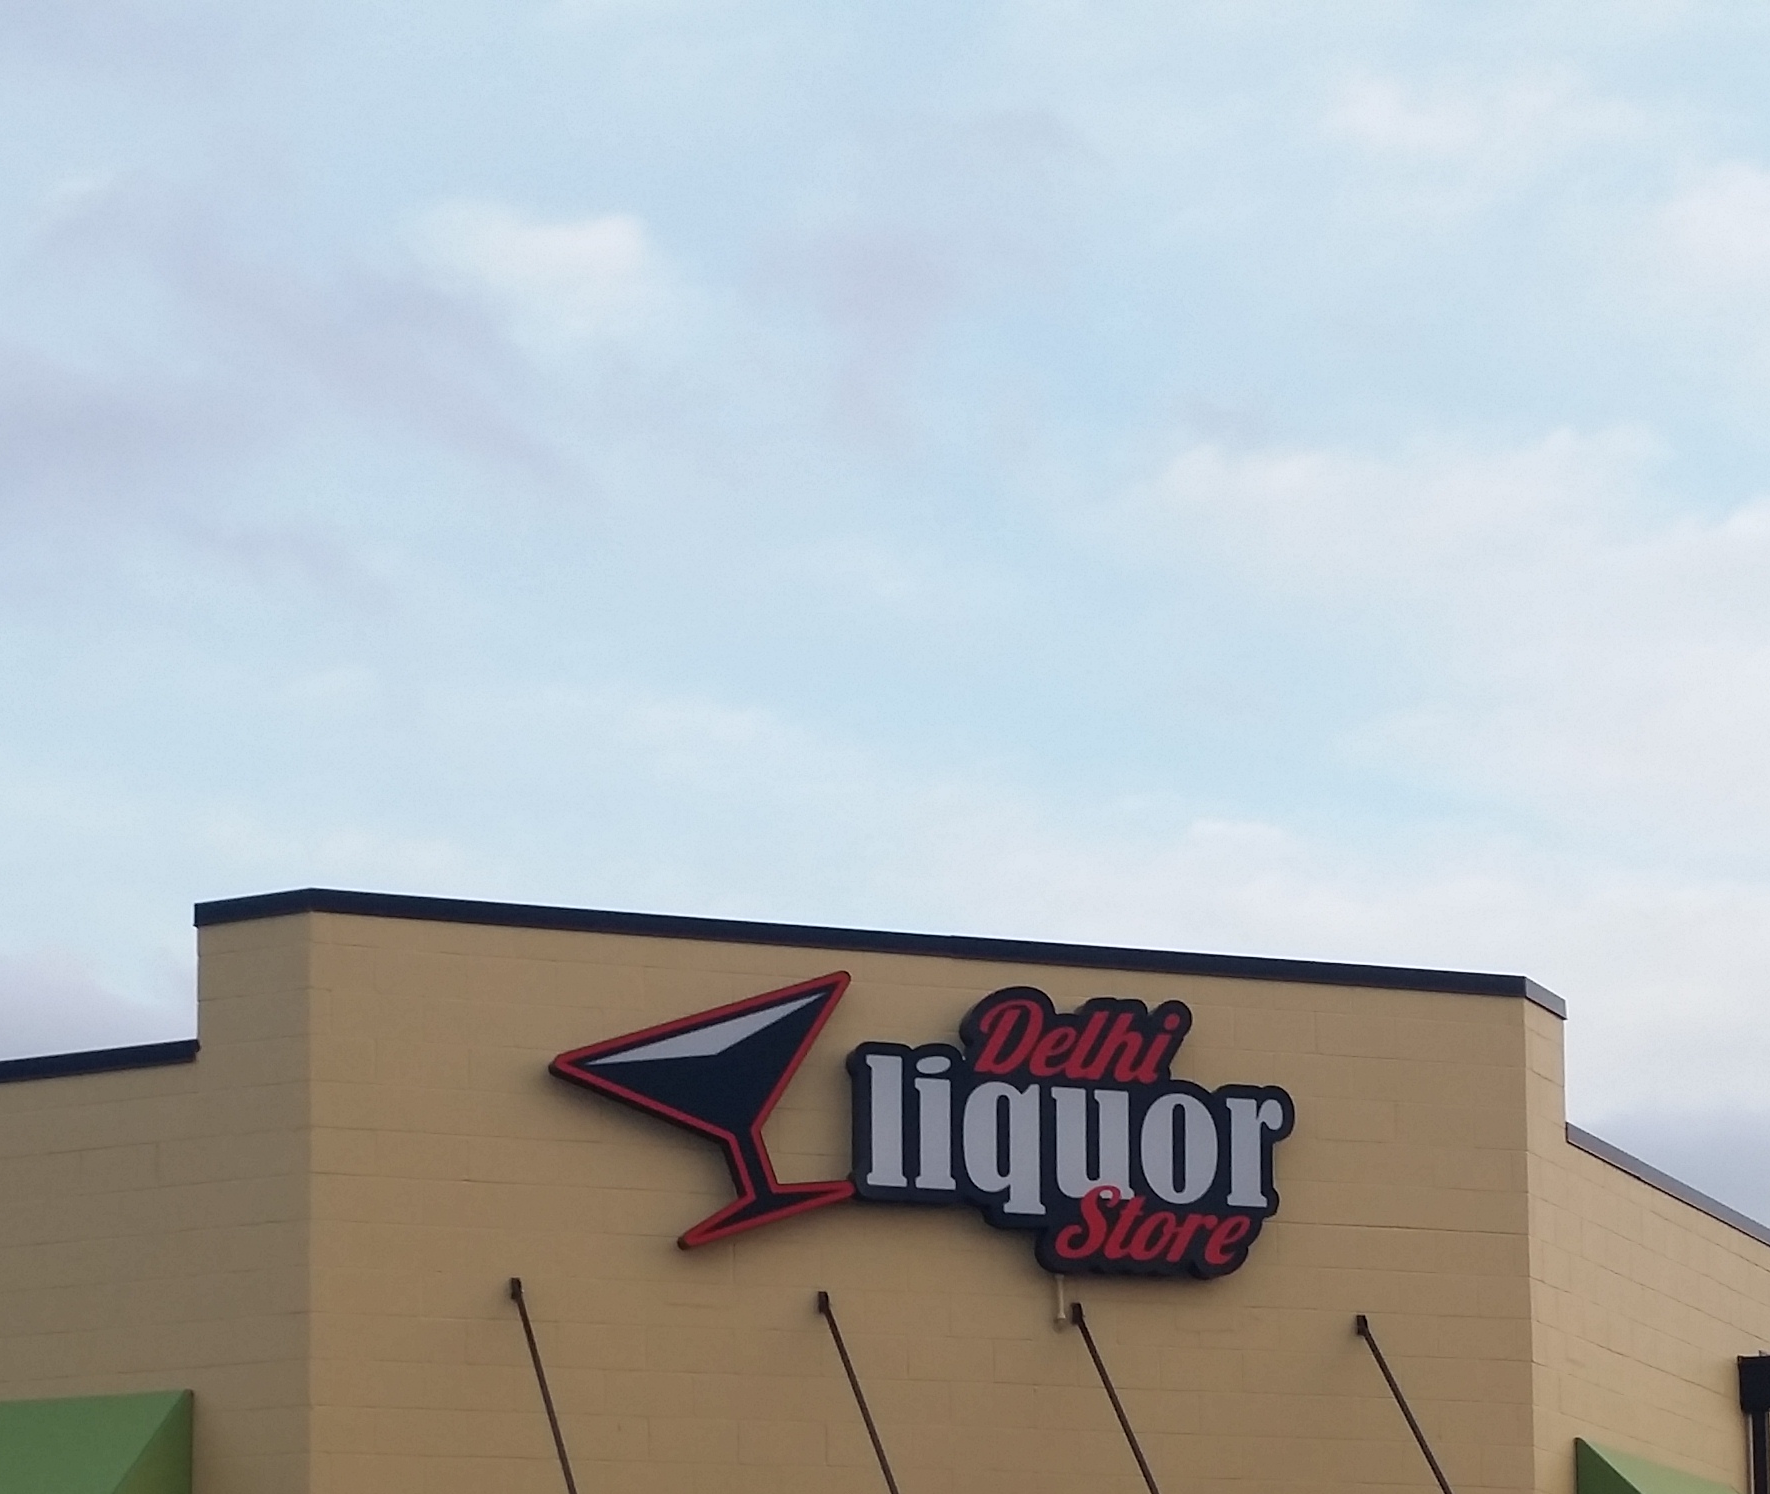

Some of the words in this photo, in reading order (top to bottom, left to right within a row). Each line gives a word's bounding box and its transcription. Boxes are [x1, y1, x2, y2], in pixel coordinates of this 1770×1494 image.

[974, 999, 1180, 1084] Delhi
[866, 1054, 1284, 1215] liquor
[1055, 1185, 1251, 1265] Store
